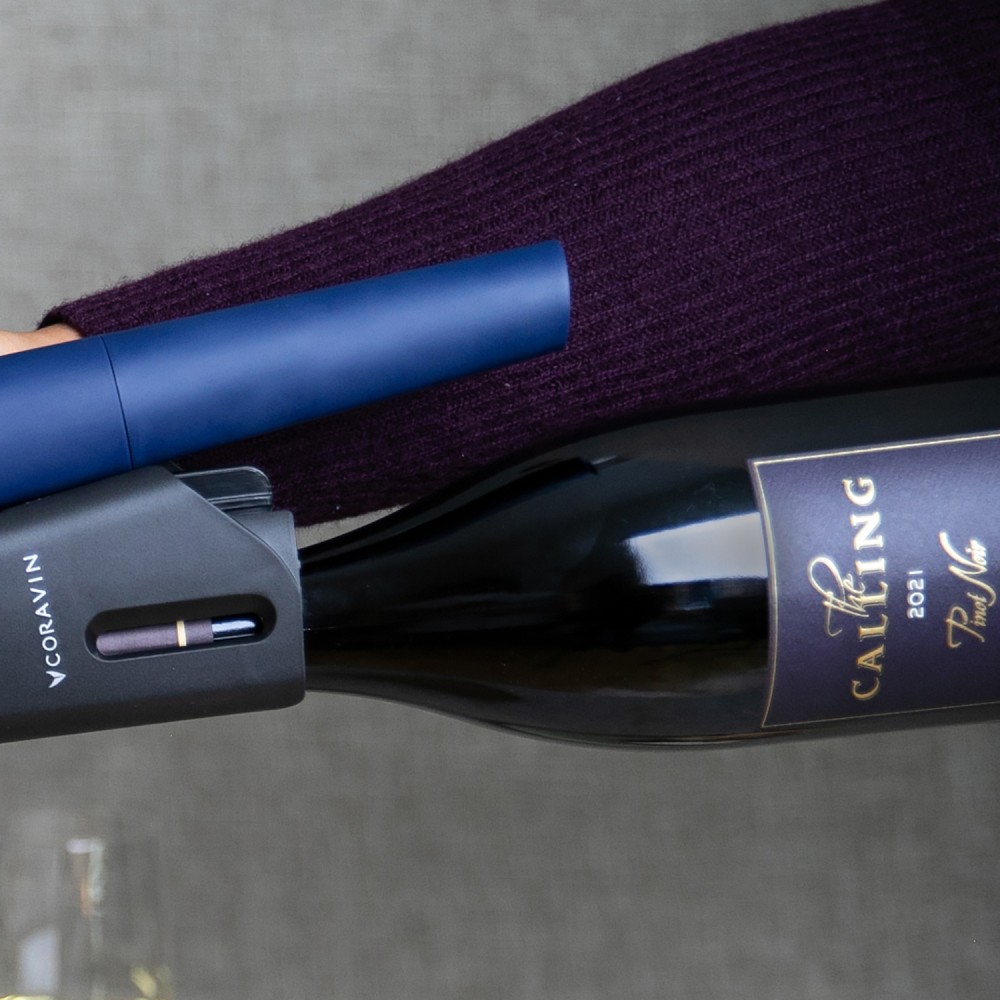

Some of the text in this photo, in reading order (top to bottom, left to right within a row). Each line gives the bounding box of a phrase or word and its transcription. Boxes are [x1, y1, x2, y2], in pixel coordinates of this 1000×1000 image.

[22, 553, 61, 668] CORAVIN
[808, 556, 869, 637] The
[841, 476, 889, 701] CALLING
[907, 569, 925, 619] 2021
[938, 531, 997, 649] Pinot Noir
